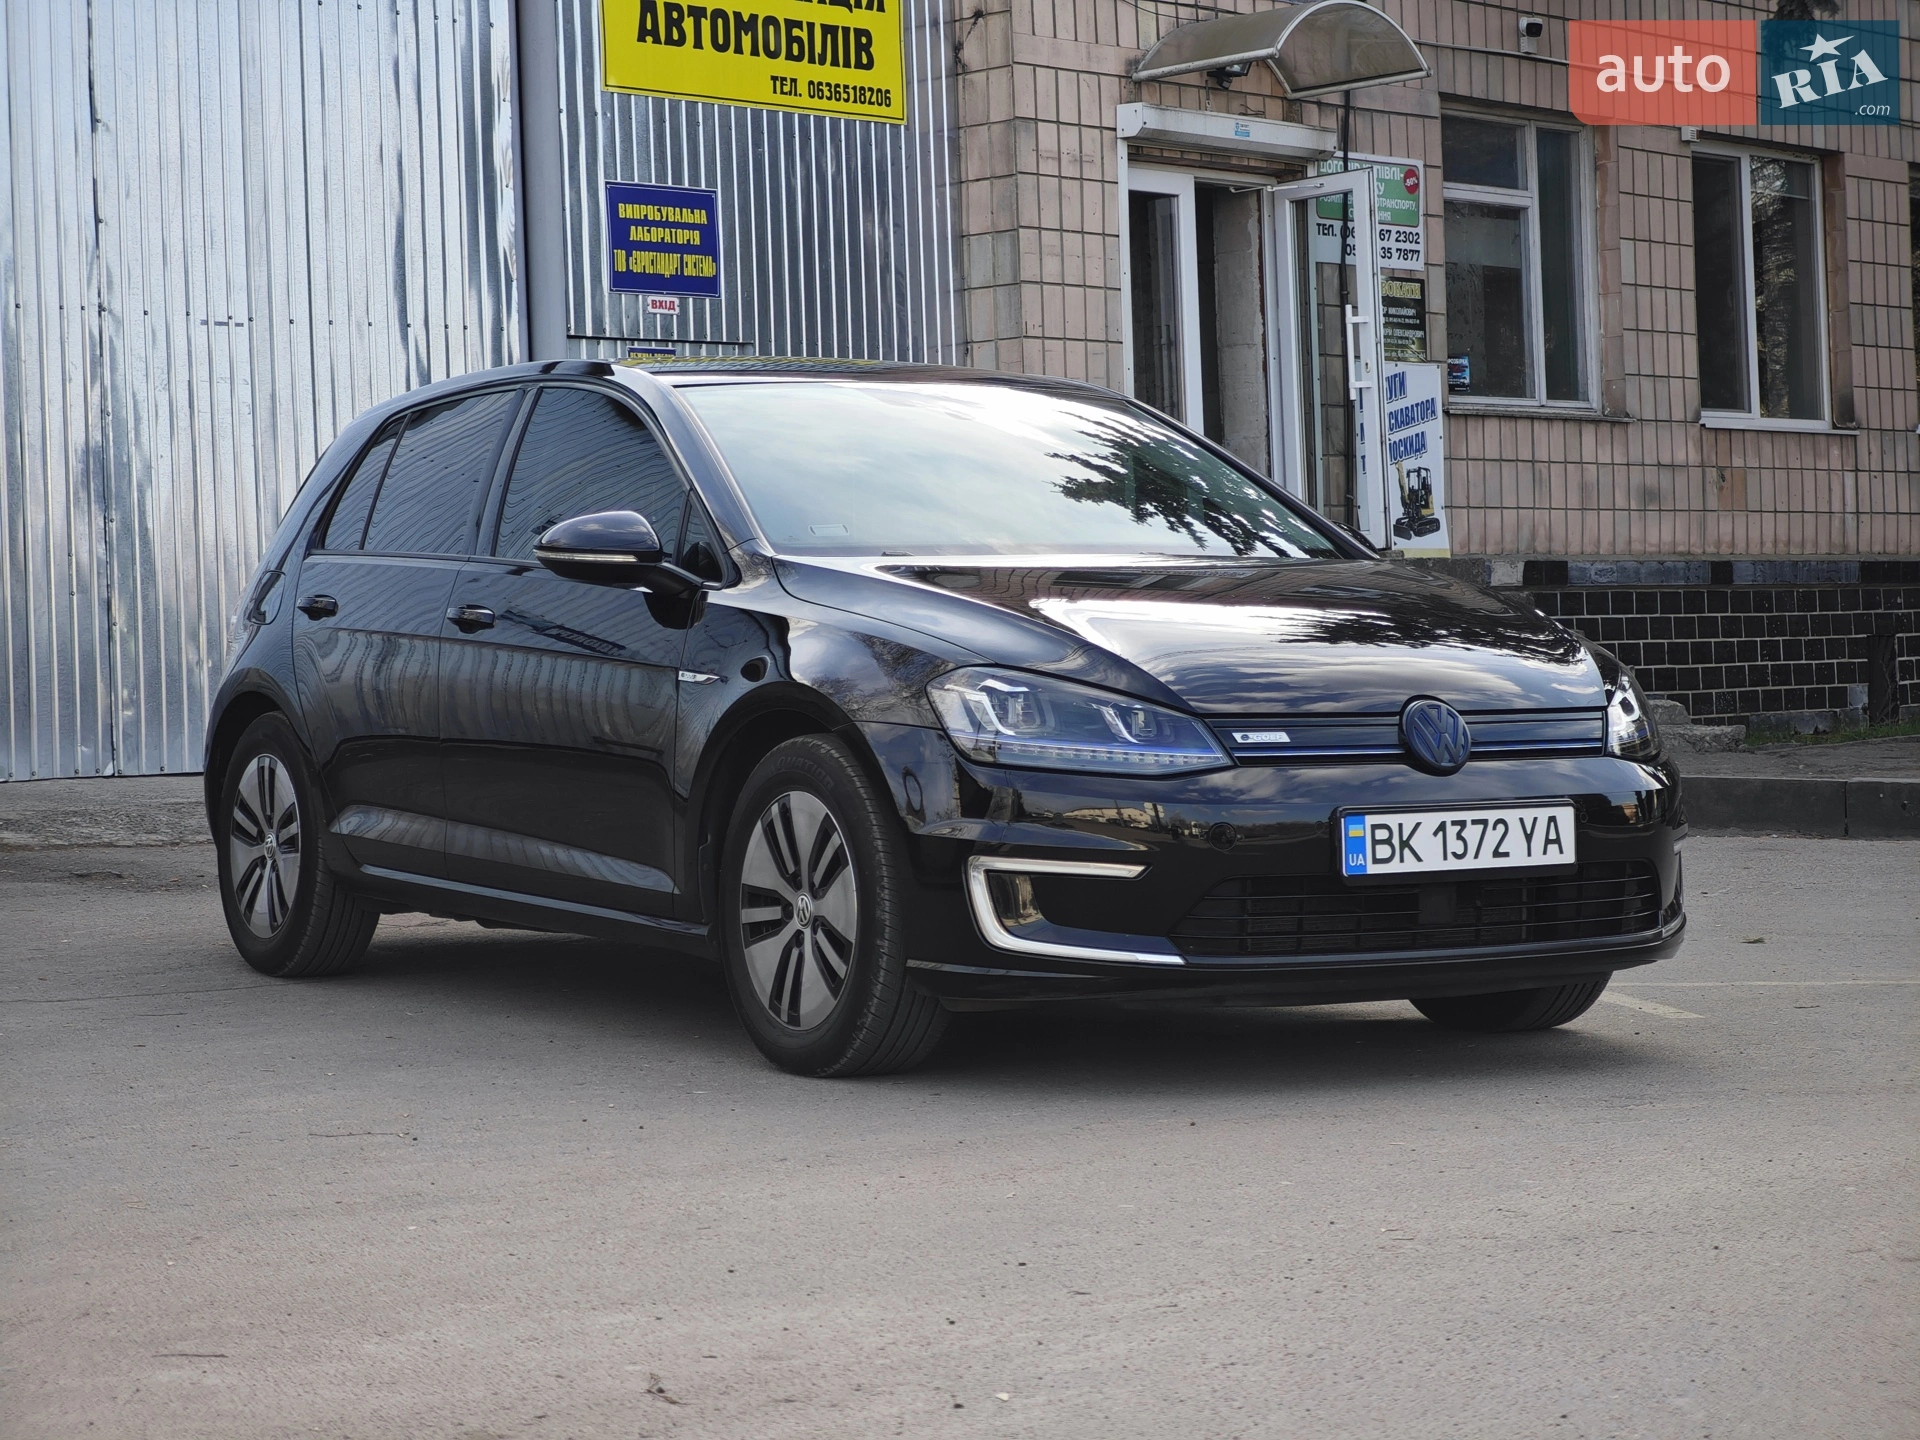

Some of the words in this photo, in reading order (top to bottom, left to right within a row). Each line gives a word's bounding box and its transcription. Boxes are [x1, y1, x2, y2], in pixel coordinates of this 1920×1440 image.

[637, 0, 875, 71] АВТОМОБІЛІВ
[770, 75, 803, 98] ТЕЛ.
[807, 79, 892, 108] 0636518206
[618, 203, 708, 225] ВИПРОБУВАЛЬНА
[629, 226, 701, 245] ЛАБОРАТОРІЯ
[1316, 223, 1337, 237] ТЕЛ.
[1395, 230, 1420, 245] 2302
[613, 249, 627, 272] ТОВ
[1379, 246, 1393, 260] 35
[1396, 247, 1420, 262] 7877
[651, 299, 676, 312] ВХІД
[1388, 397, 1437, 433] СКАВАТОРА
[1370, 821, 1424, 865] BK
[1432, 818, 1510, 861] 1372
[1518, 815, 1564, 857] YA
[1349, 853, 1366, 866] UA
